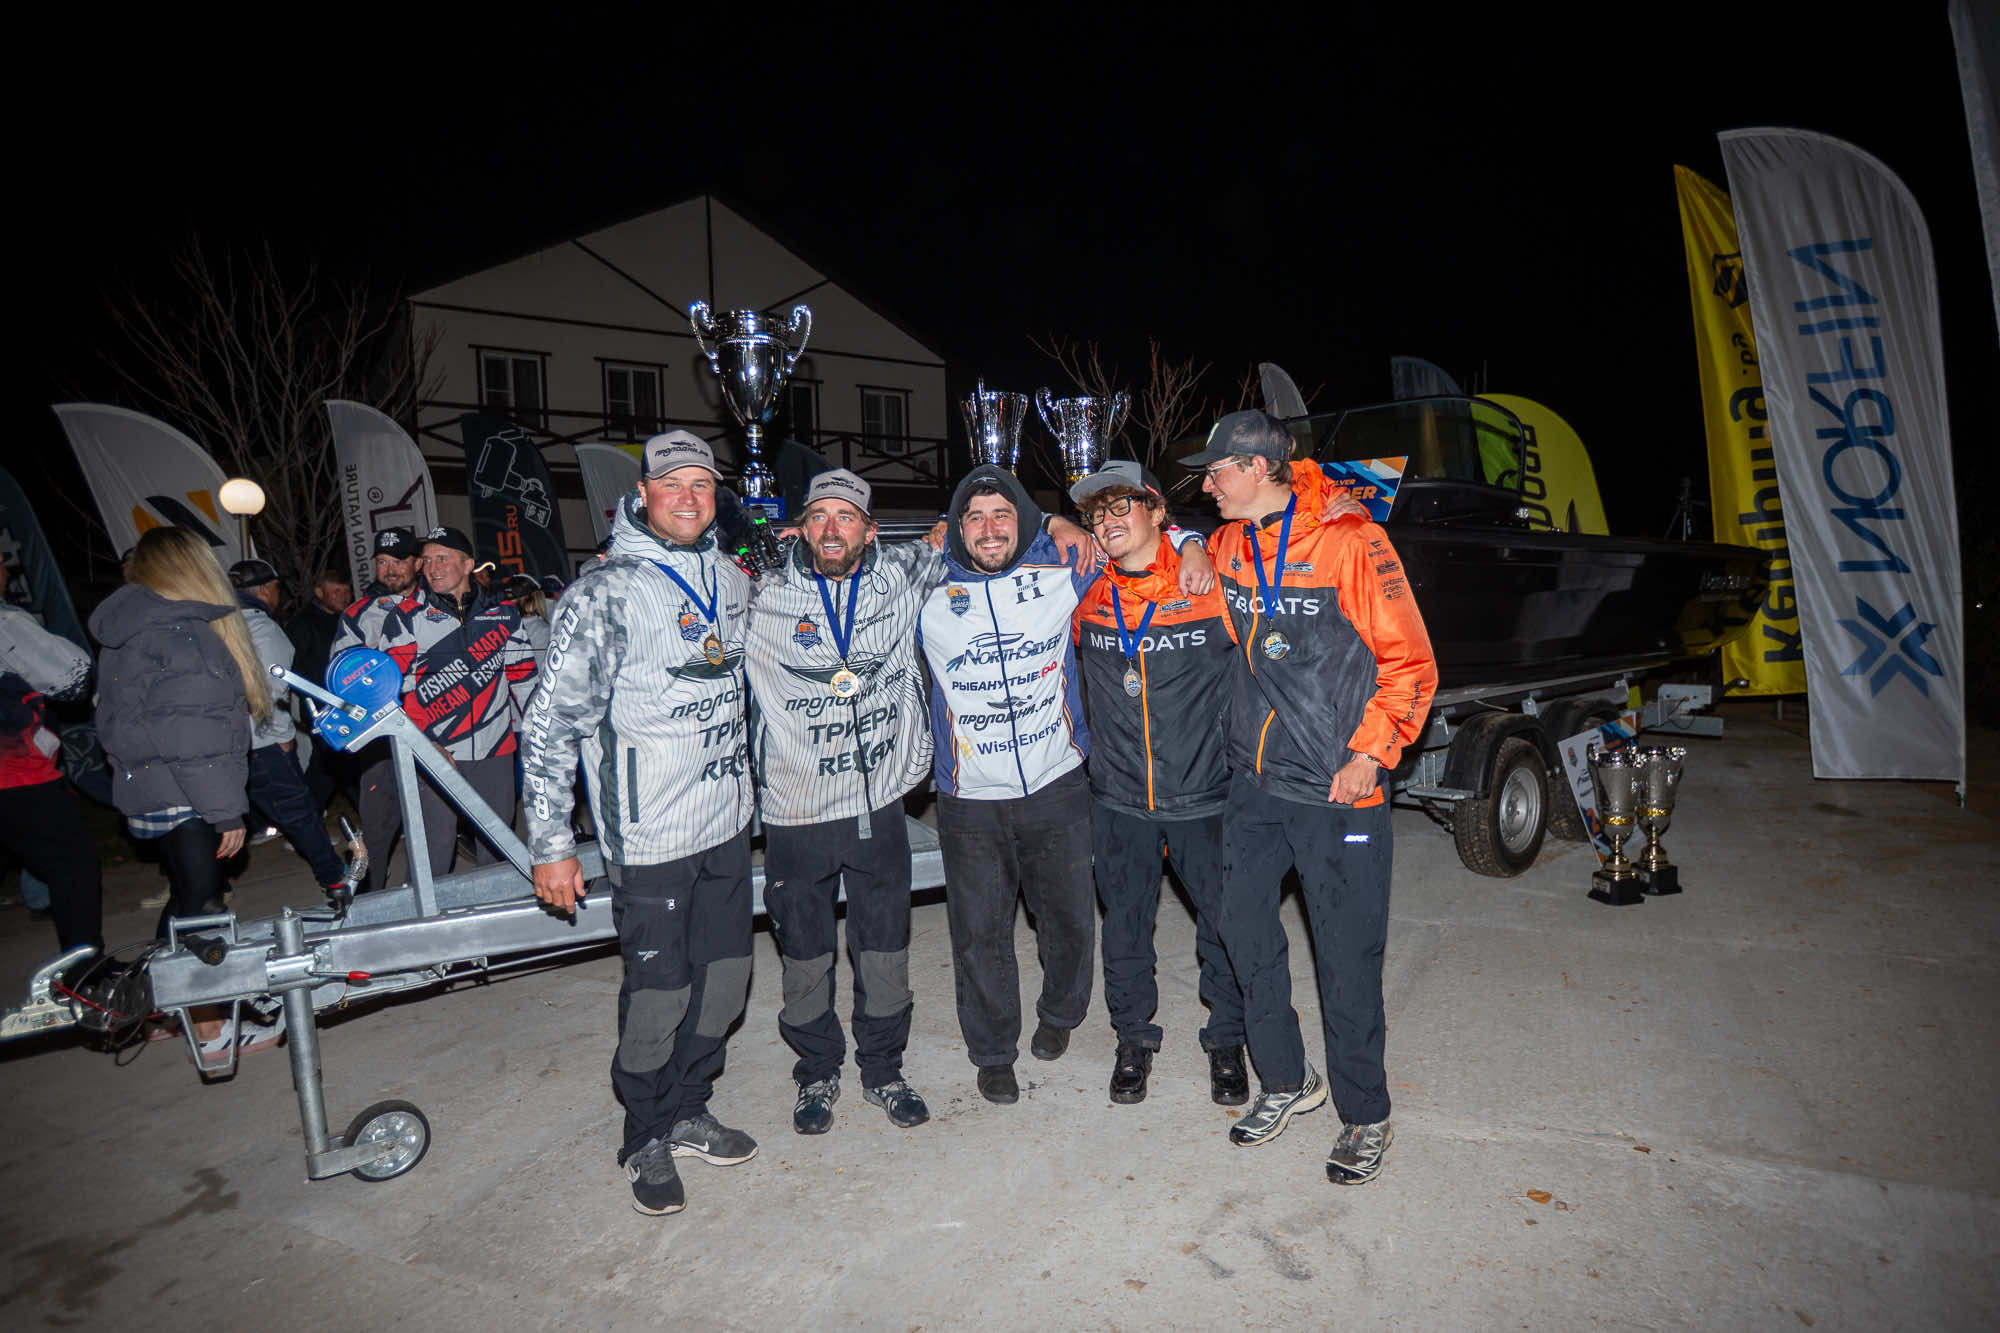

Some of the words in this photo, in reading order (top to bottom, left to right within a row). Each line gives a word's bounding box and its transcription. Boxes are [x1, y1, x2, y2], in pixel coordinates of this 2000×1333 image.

[1223, 586, 1320, 616] FBOATS
[418, 658, 471, 703] FISHING
[807, 702, 898, 745] ТРИЕРА
